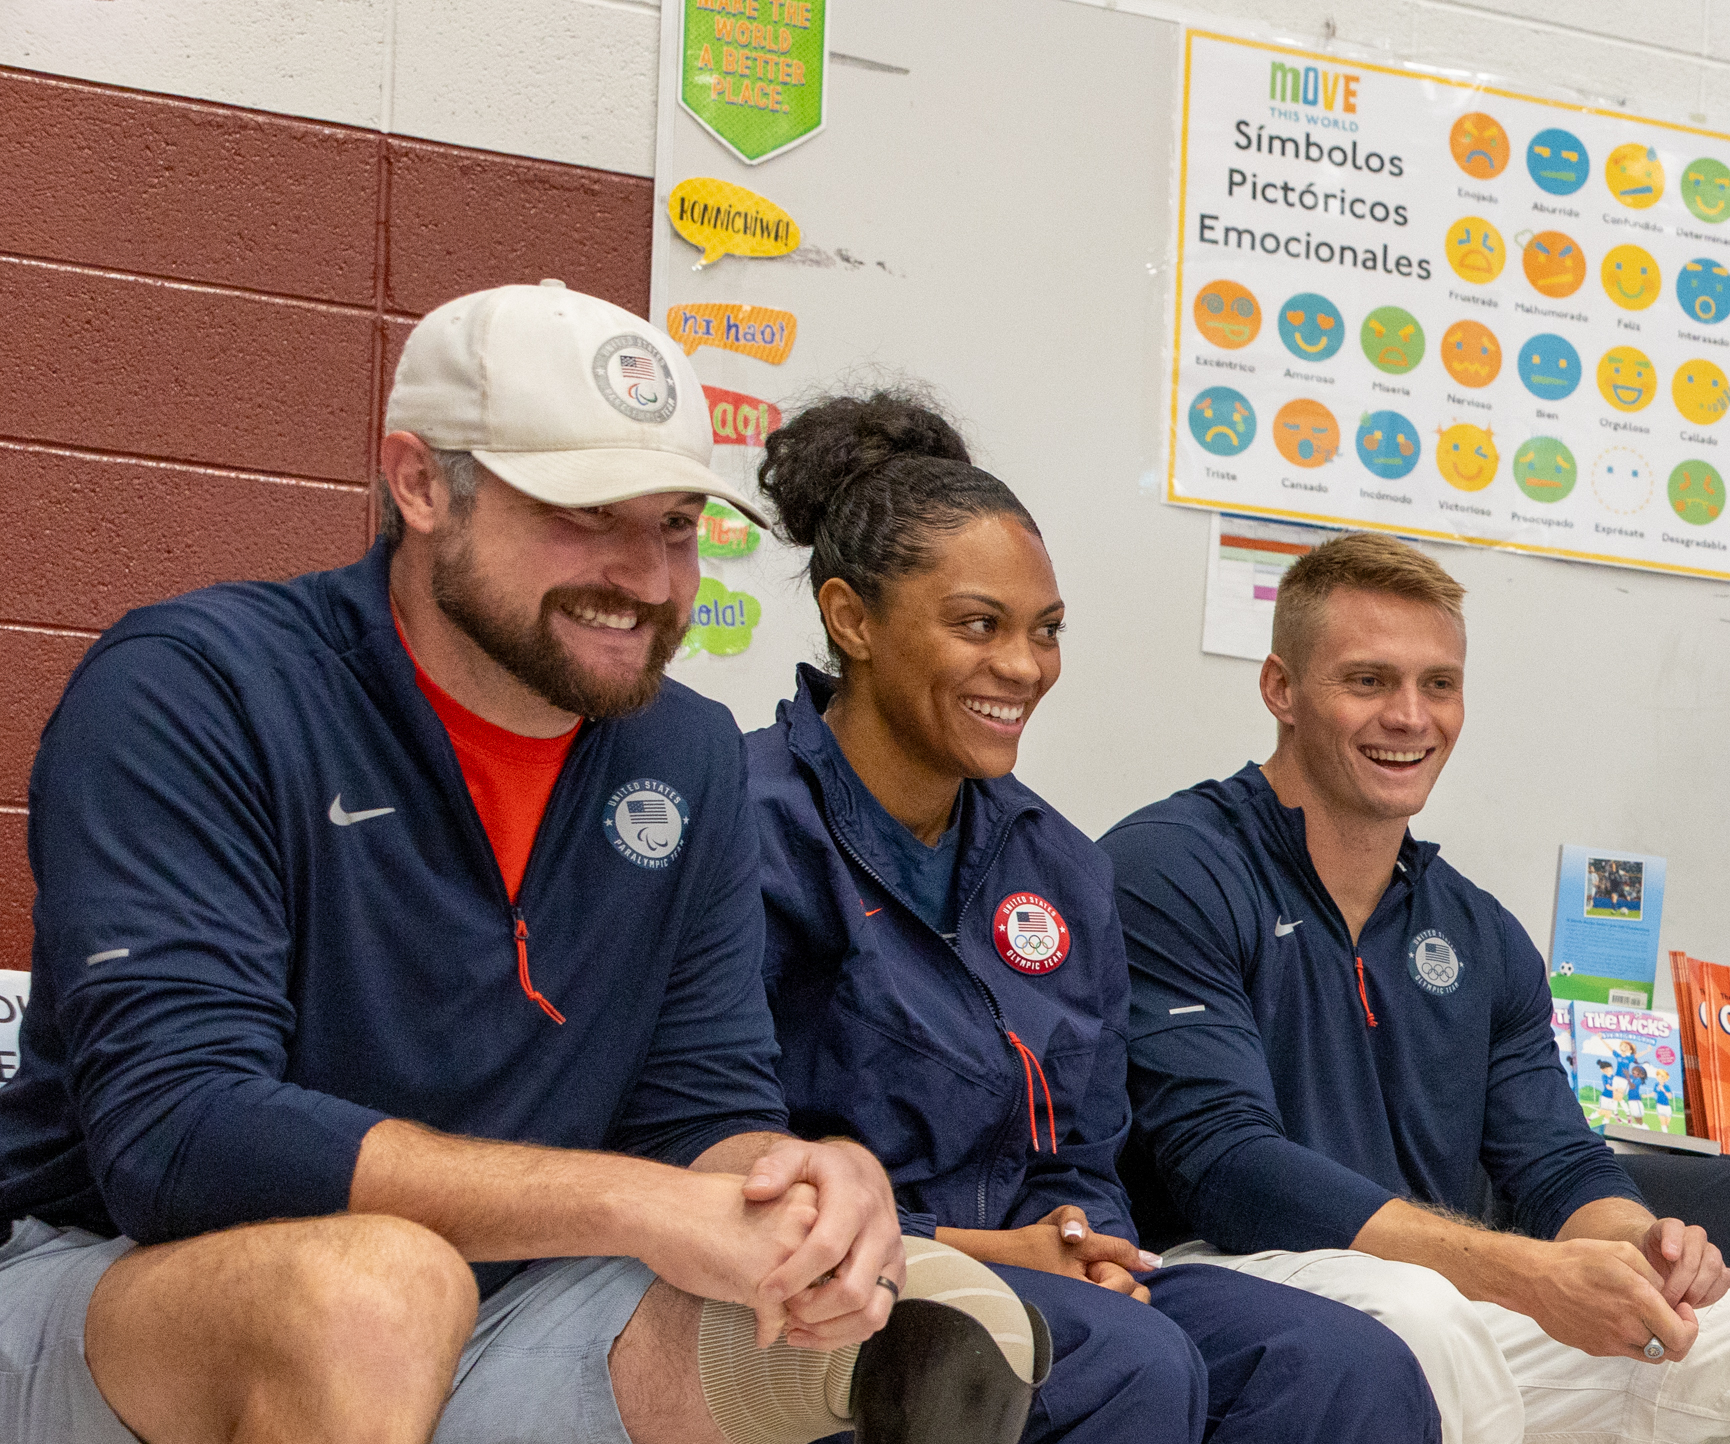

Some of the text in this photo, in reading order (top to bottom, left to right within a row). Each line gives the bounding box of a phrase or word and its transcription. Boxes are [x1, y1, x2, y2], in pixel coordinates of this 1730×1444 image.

[769, 0, 811, 30] THE
[715, 16, 792, 55] WORLD
[698, 43, 805, 87] A BETTER
[711, 74, 789, 114] PLACE.
[1270, 61, 1360, 114] MOVE
[1270, 106, 1359, 132] THIS WORLD
[1234, 119, 1404, 177] Símbolos
[1228, 167, 1408, 226] Pictóricos
[1457, 187, 1498, 205] Enojado
[1531, 202, 1580, 218] Aburrido
[1602, 213, 1664, 233] Confundido
[1199, 213, 1432, 280] Emocionales
[1449, 290, 1498, 308] Frustrado
[1514, 302, 1588, 322] Malhumorado
[725, 314, 786, 347] hao!
[1617, 318, 1640, 332] Feliz
[1678, 330, 1730, 347] Interesado
[1195, 356, 1256, 374] Excéntrico
[1284, 368, 1335, 385] Amoroso
[1372, 381, 1410, 397] Miseria
[1447, 394, 1492, 411] Nervioso
[1536, 409, 1558, 421] Bien
[1599, 417, 1650, 435] Orgulloso
[1680, 431, 1718, 446] Callado
[1205, 467, 1237, 481] Triste
[1281, 478, 1328, 493] Cansado
[1359, 487, 1412, 505] Incómodo
[1438, 500, 1491, 517] Victorioso
[1511, 511, 1574, 529] Preocupado
[1594, 522, 1645, 539] Exprésate
[1662, 533, 1727, 552] Desagradable
[691, 598, 746, 627] ola!
[608, 780, 682, 807] UNITED STATES
[614, 839, 685, 868] PARALYMPIC TEAM
[1003, 895, 1056, 917] UNITED STATES
[1413, 929, 1436, 945] UNITED
[1006, 949, 1063, 970] OLYMPIC TEAM
[1415, 974, 1459, 994] OLYMPIC TEAM
